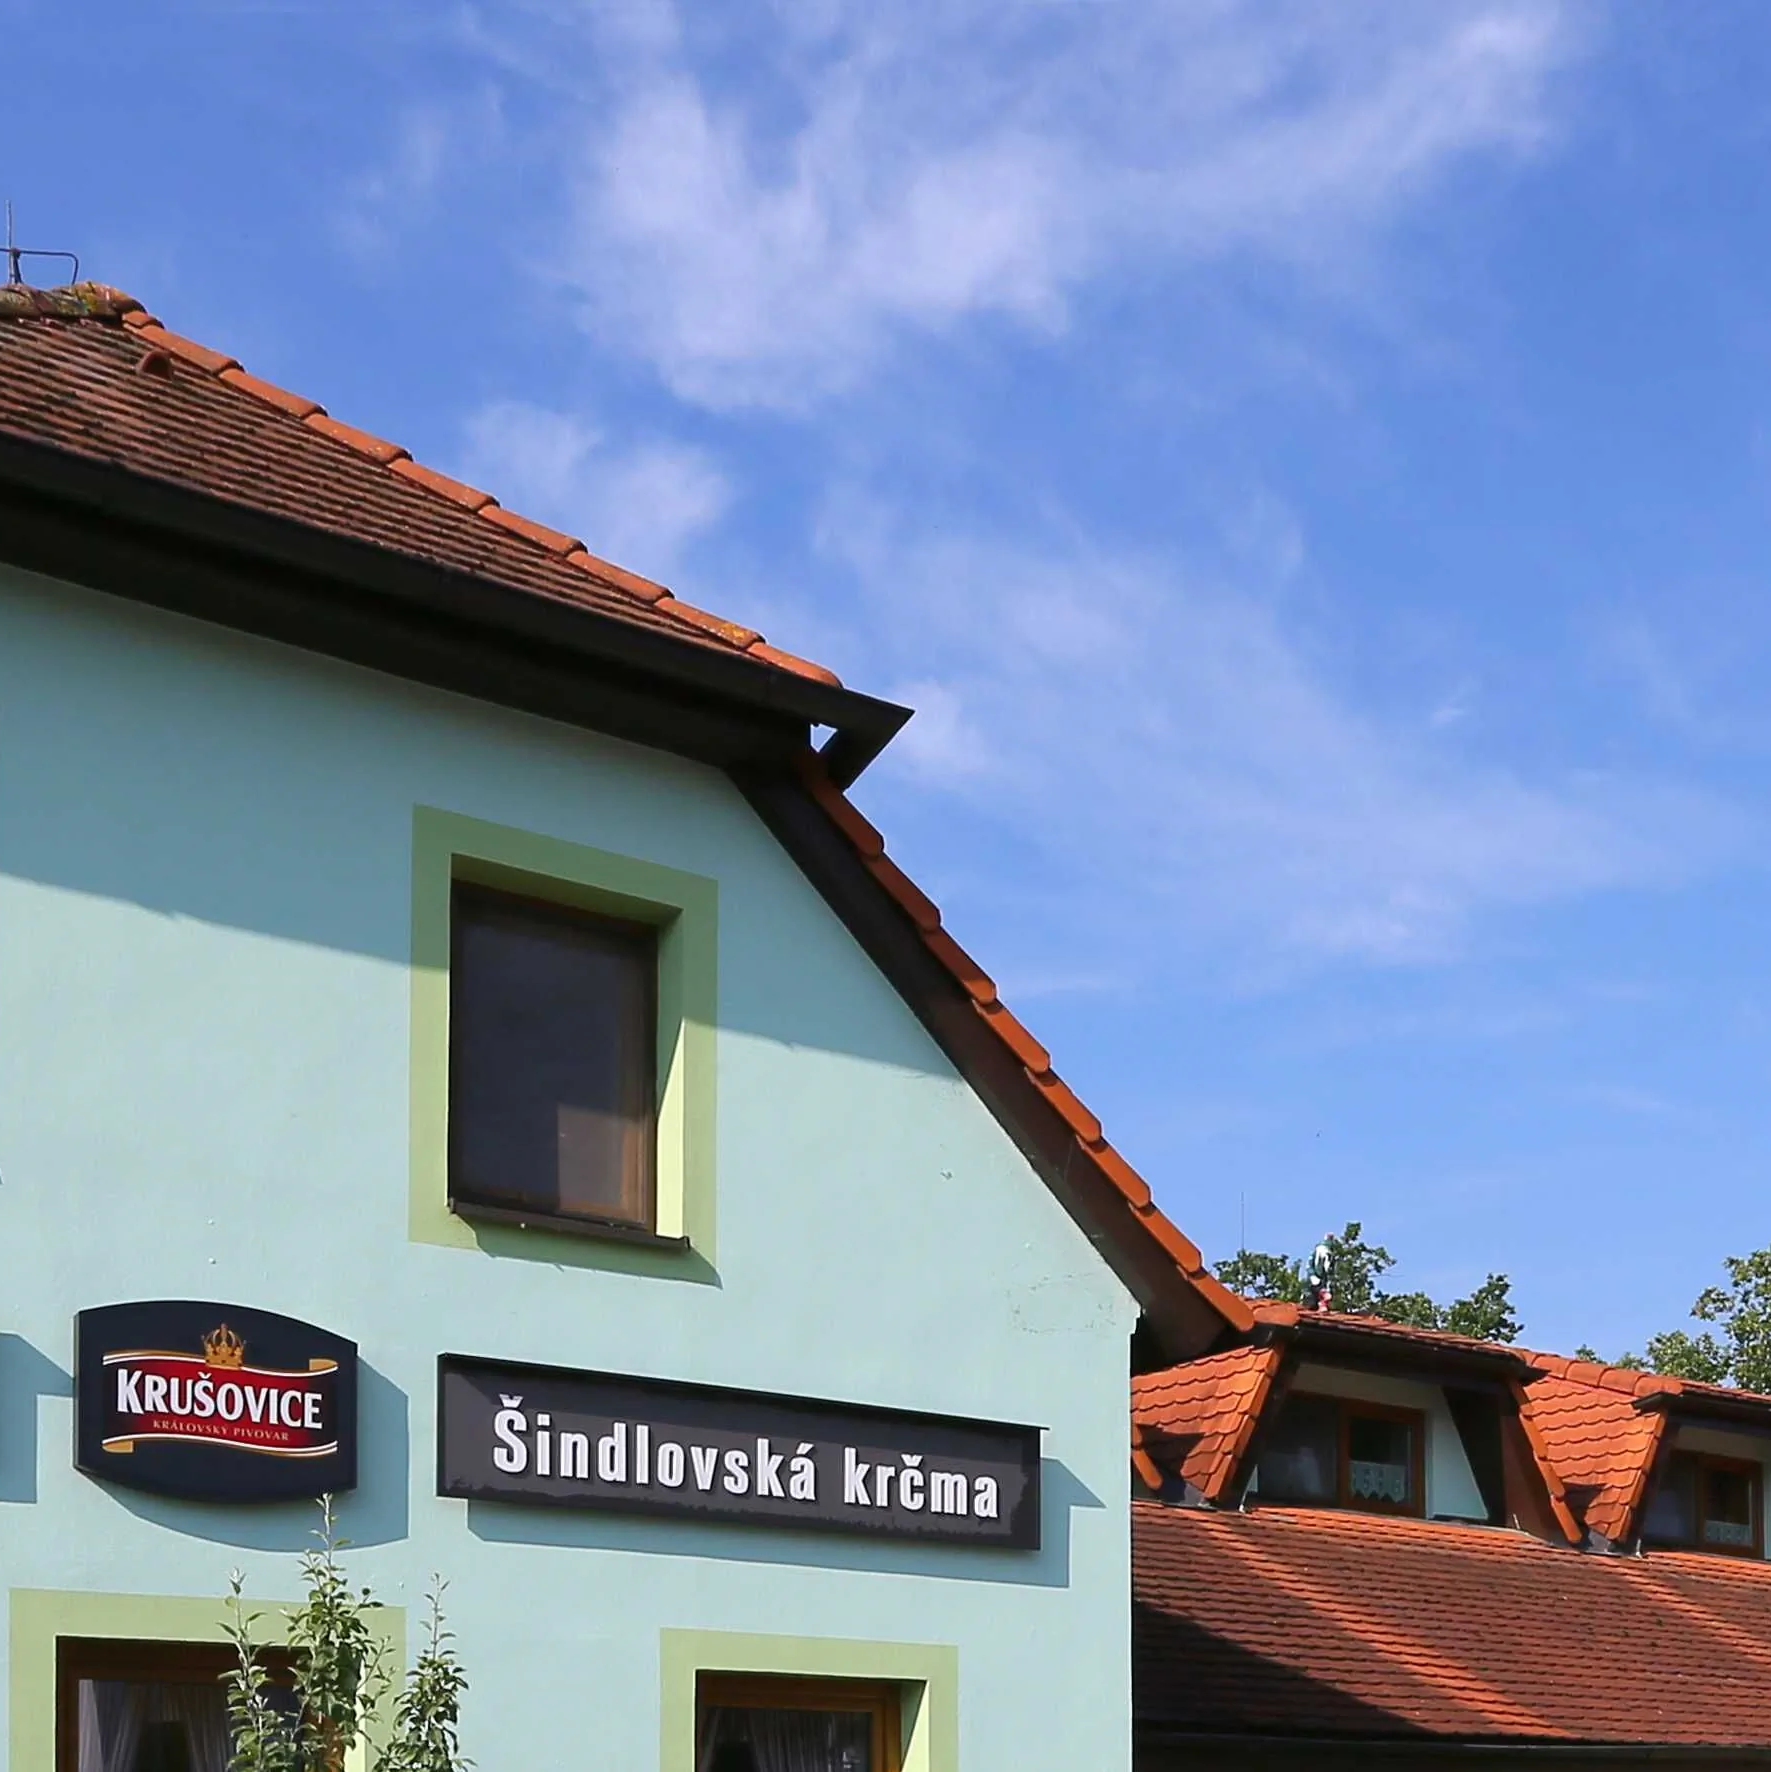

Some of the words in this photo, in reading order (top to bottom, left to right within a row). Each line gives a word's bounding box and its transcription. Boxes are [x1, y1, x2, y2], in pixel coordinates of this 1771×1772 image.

[116, 1367, 324, 1430] KRUŠOVICE
[233, 1426, 290, 1441] PIVOVAR
[492, 1392, 817, 1502] Šindlovská
[842, 1445, 999, 1519] krčma
